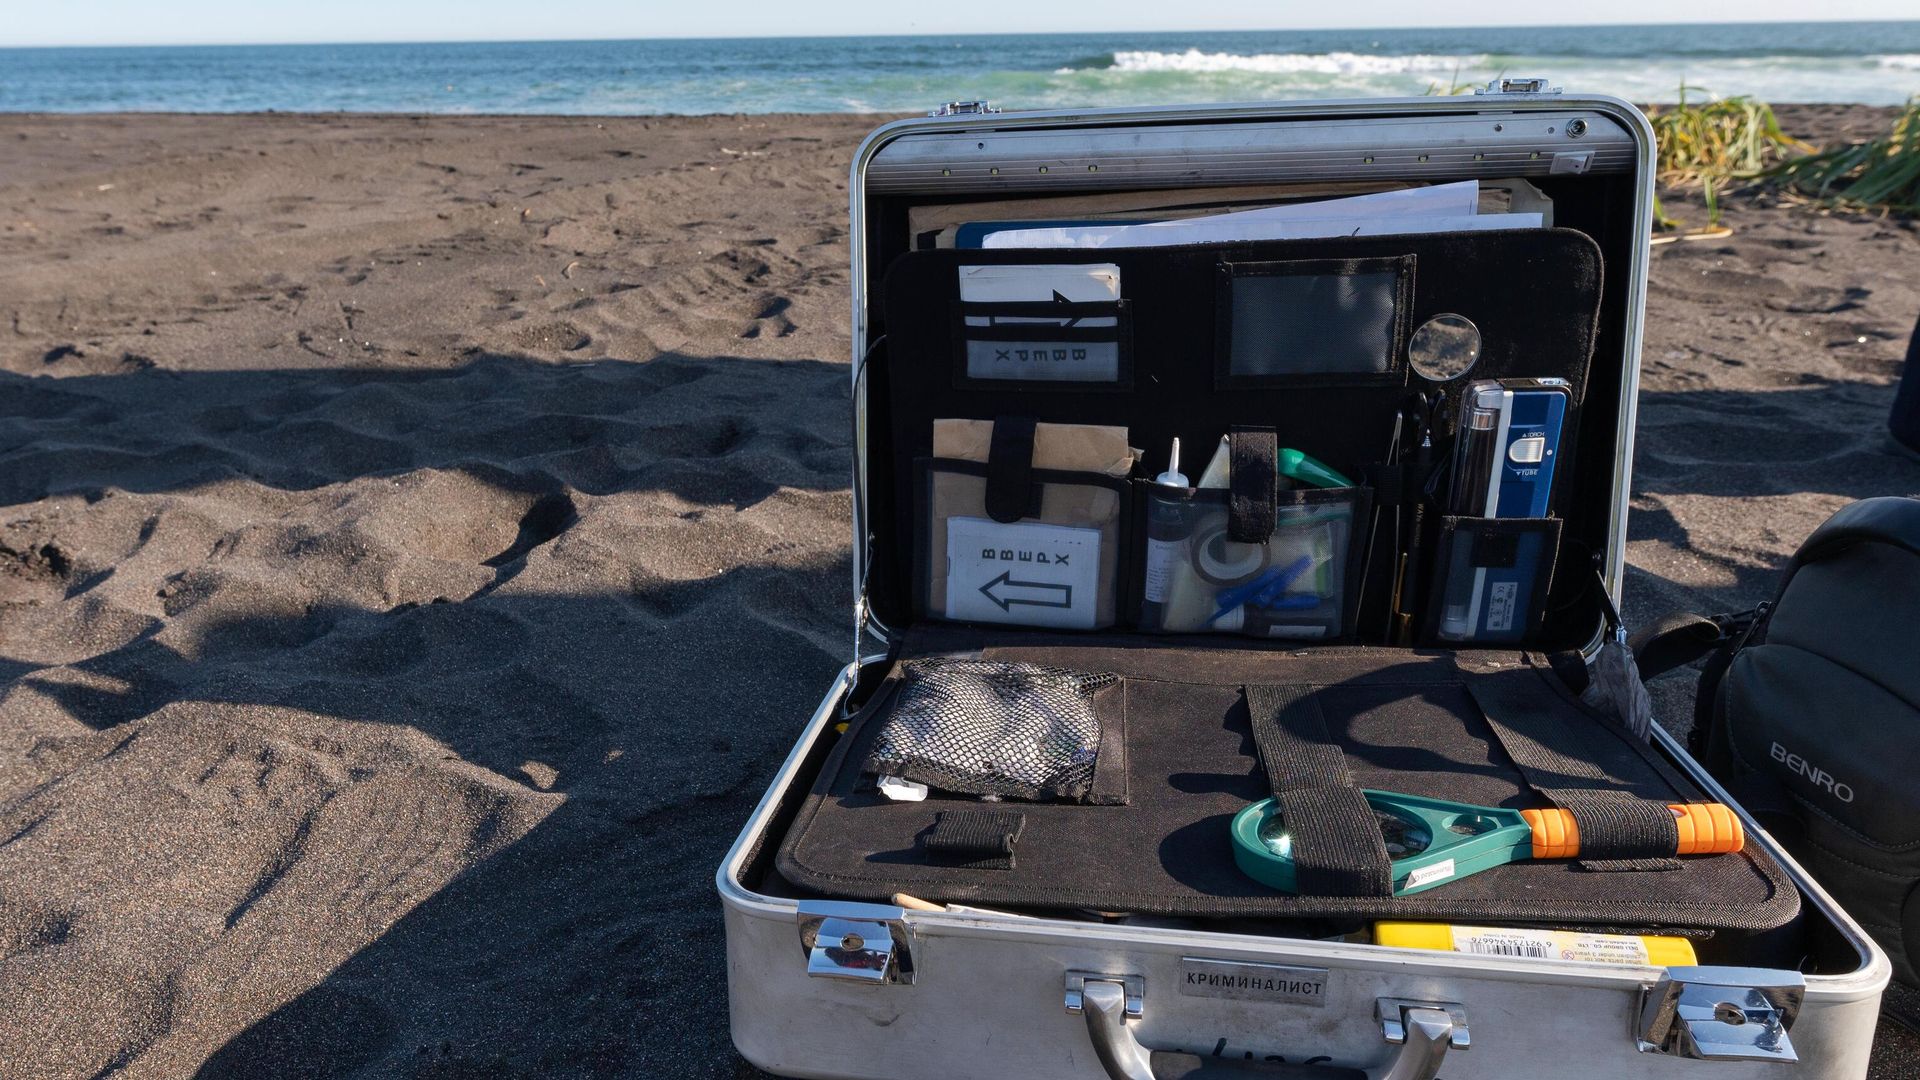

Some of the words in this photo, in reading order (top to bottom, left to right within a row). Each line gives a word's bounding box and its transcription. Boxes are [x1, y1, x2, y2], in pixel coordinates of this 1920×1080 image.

[996, 348, 1086, 362] ВВЕРХ
[982, 548, 1070, 566] ВВЕРХ
[1770, 741, 1854, 803] BENRO
[1187, 972, 1322, 995] КРИМИНАЛИСТ
